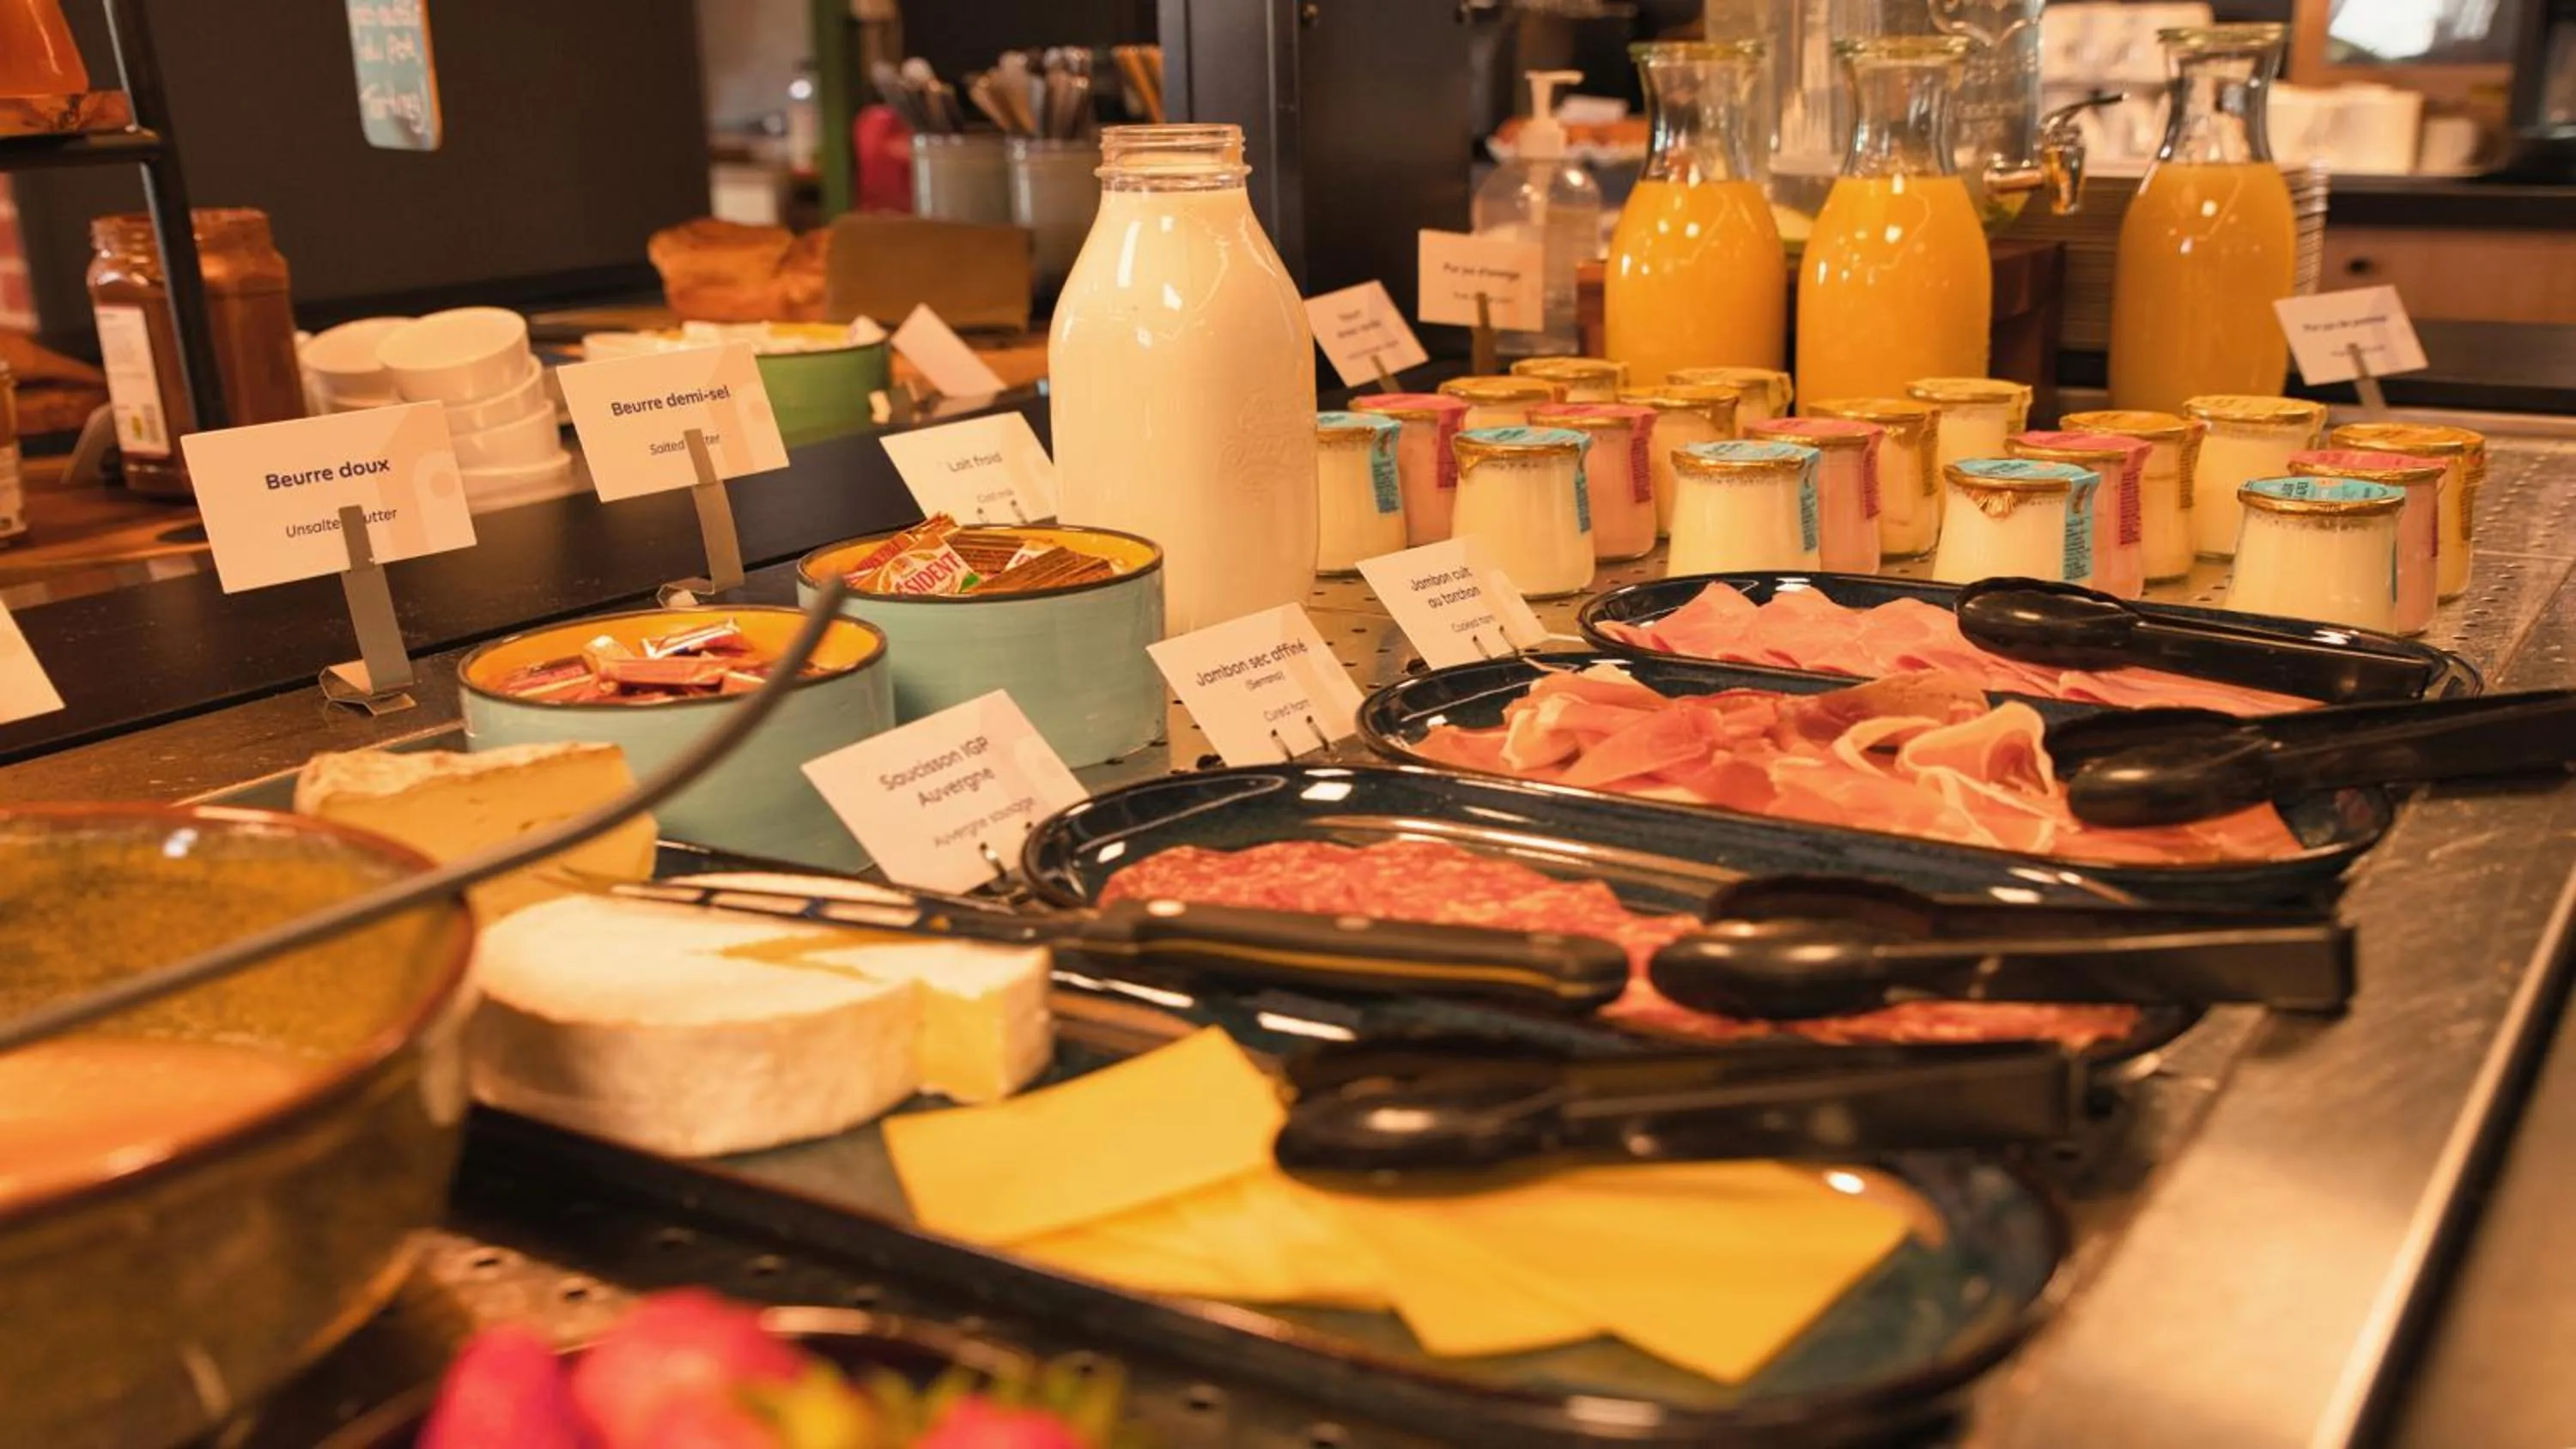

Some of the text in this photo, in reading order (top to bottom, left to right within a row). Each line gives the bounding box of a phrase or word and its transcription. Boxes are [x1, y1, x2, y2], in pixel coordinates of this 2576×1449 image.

[609, 385, 730, 416] Beurre demi-sel
[649, 439, 685, 456] Salted
[947, 452, 1003, 472] Lait froid
[265, 459, 390, 490] Beurre doux
[285, 507, 397, 538] Unsalte utter
[1411, 566, 1473, 591] Jambon cuit
[1428, 585, 1480, 609] au torchon
[1196, 638, 1309, 688] Jambon sec affiné
[1262, 698, 1311, 723] Cured ham
[878, 735, 989, 791] Saucisson IGP
[917, 767, 996, 808] Auvergne
[933, 816, 989, 849] Auvergne
